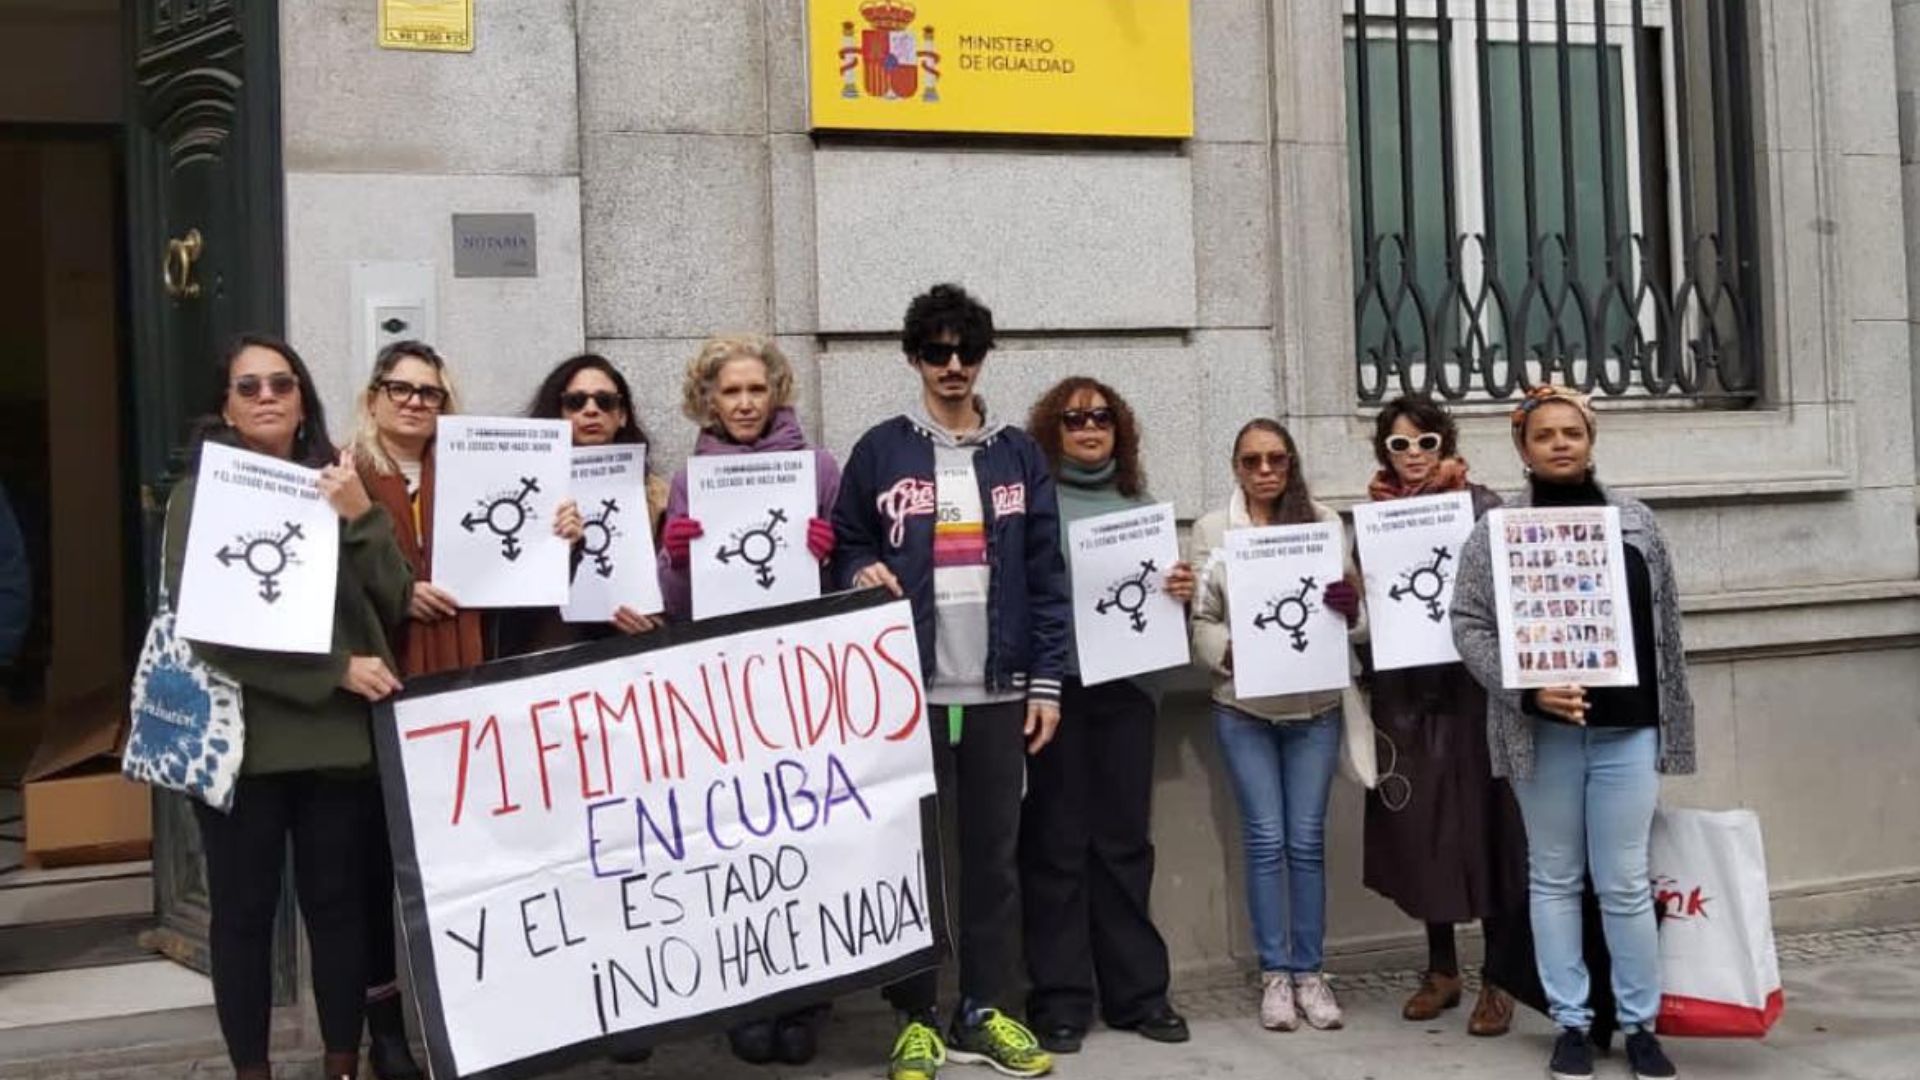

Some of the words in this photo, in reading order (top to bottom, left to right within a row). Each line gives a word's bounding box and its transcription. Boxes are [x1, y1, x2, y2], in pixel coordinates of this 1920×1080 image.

[959, 35, 1054, 54] MINISTERIO
[959, 54, 983, 71] DE
[987, 55, 1075, 75] IGUALDAD
[405, 715, 521, 826] 71
[529, 626, 921, 811] FEMINICIDIOS
[586, 788, 684, 879] EN
[706, 752, 871, 850] CUBA
[446, 908, 487, 982] Y
[520, 888, 586, 958] EL
[620, 844, 809, 931] ESTADO
[715, 899, 811, 991] HACE
[818, 849, 930, 964] NADA!
